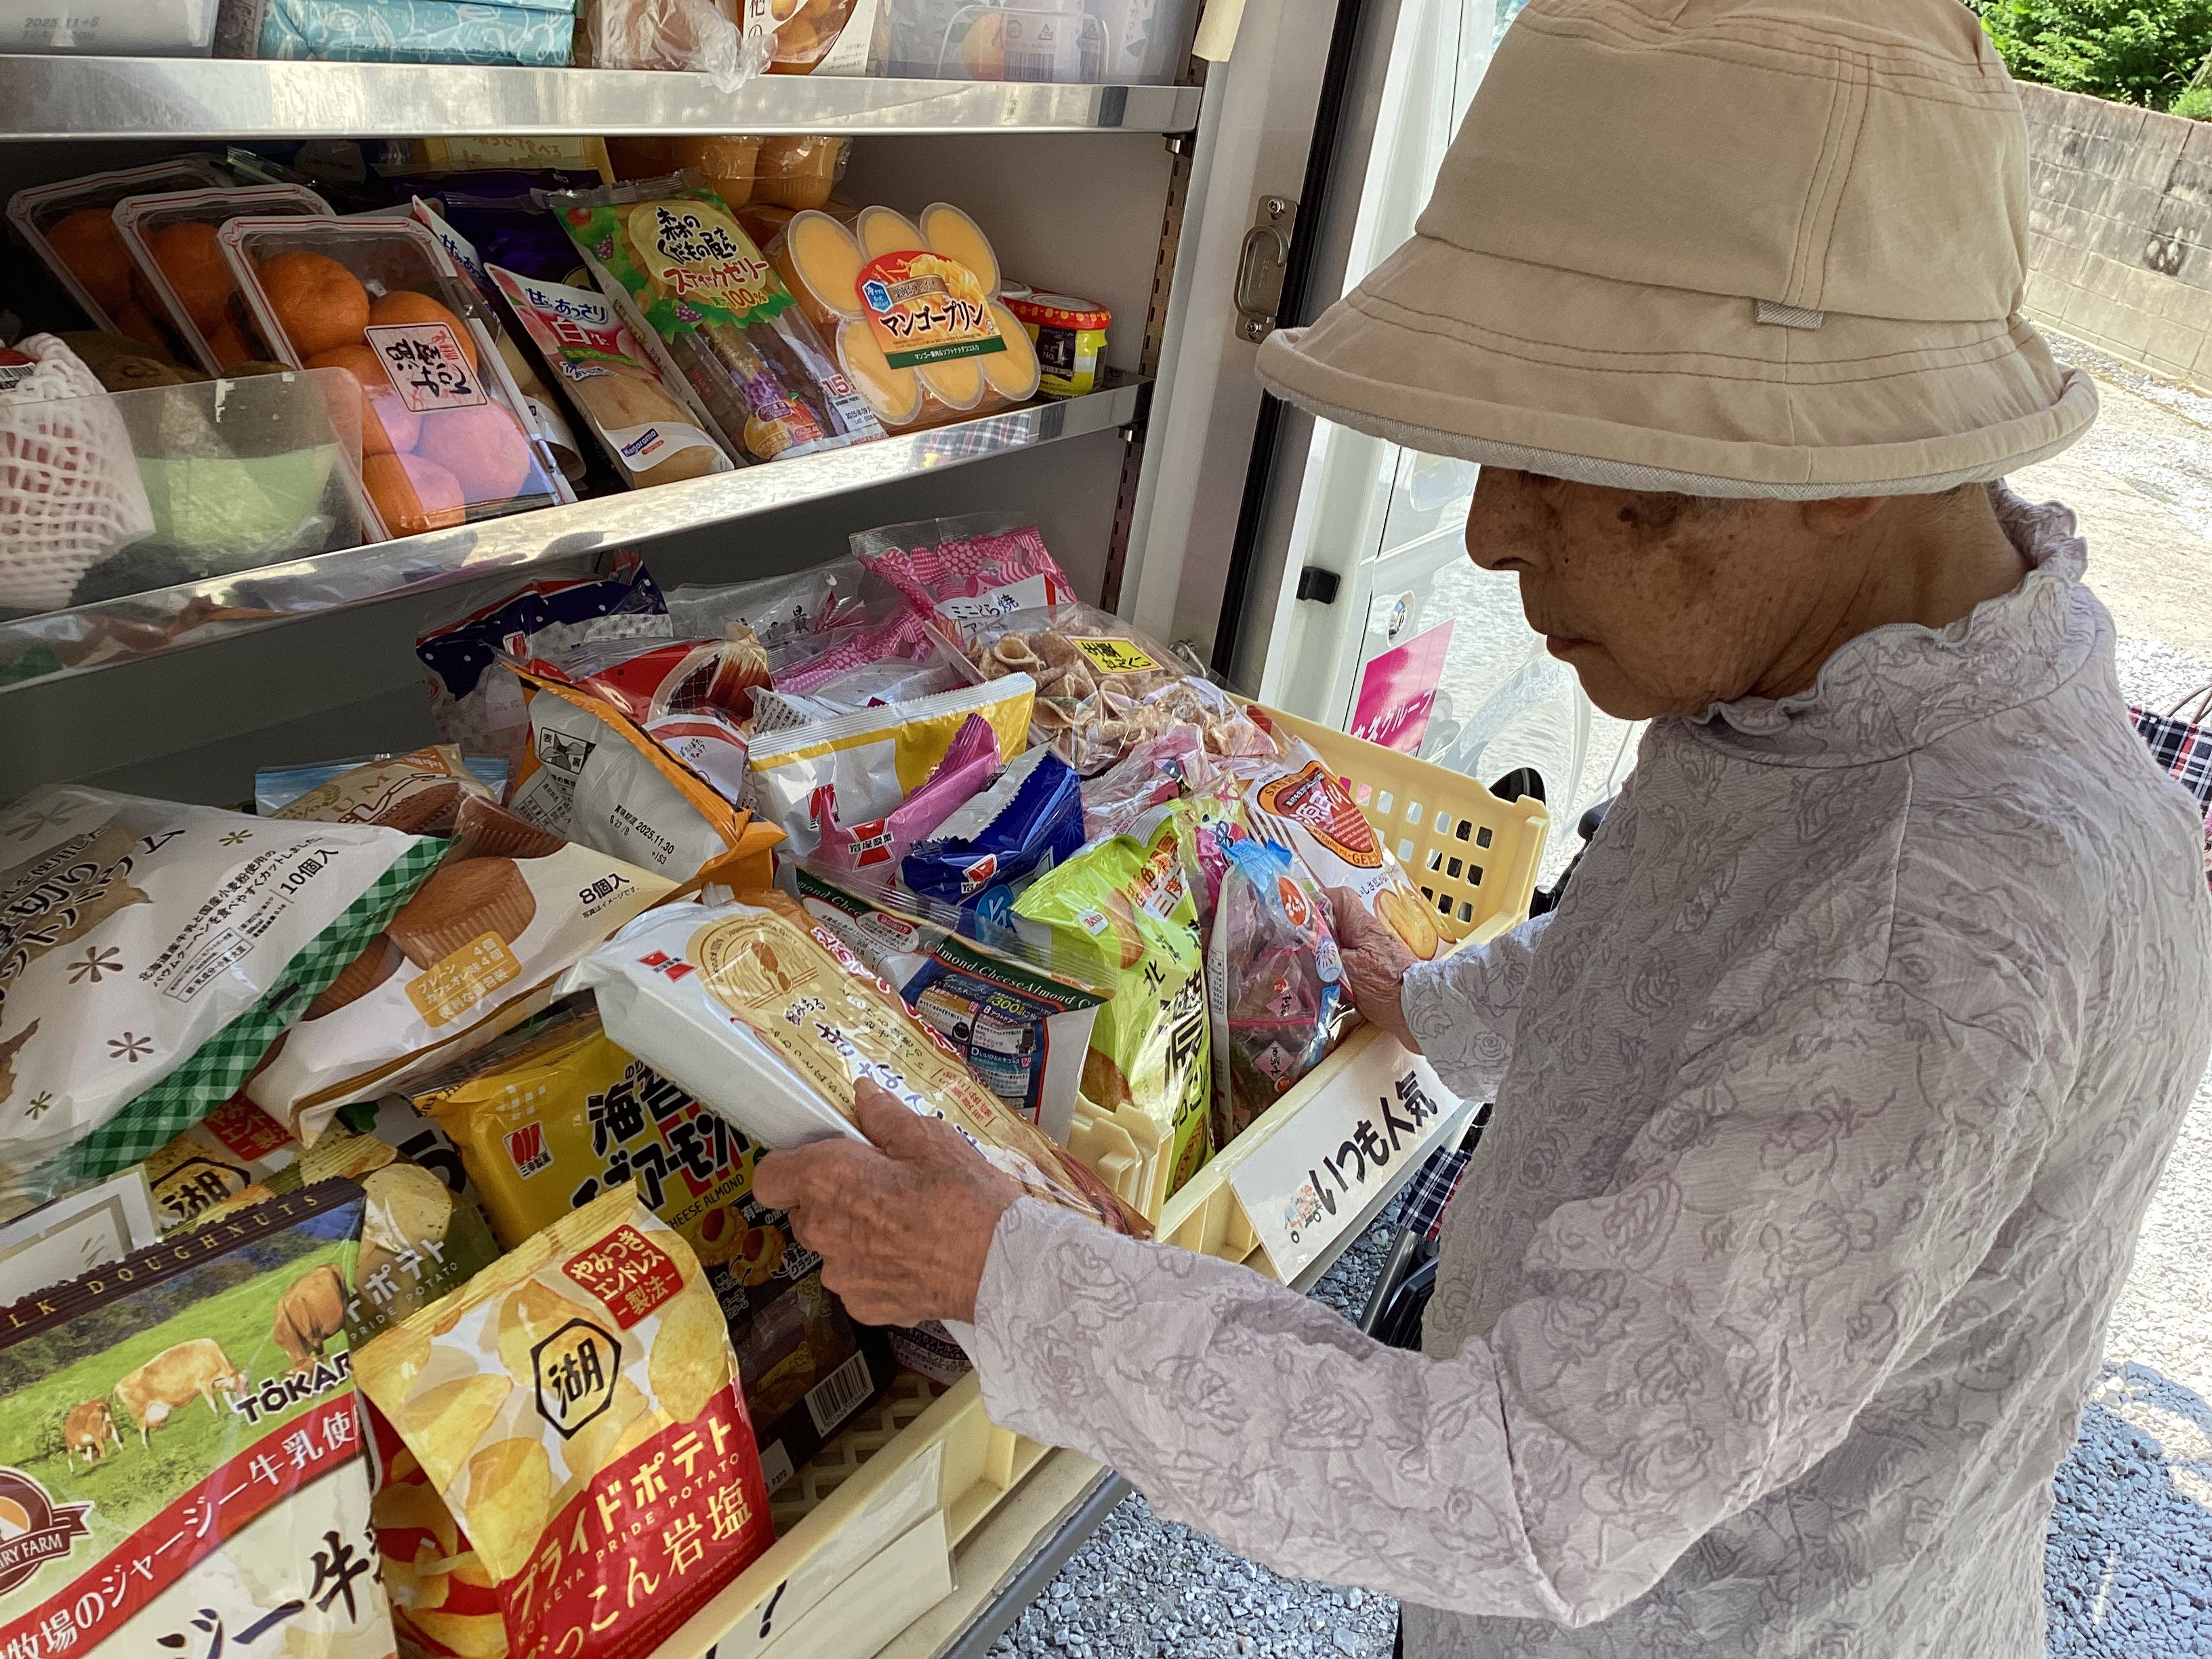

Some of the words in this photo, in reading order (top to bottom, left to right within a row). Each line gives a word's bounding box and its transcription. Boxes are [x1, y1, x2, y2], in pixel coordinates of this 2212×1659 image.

[657, 207, 701, 241] 森の
[657, 226, 737, 266] くだもの屋さん
[880, 300, 983, 337] マンゴープリン
[951, 593, 1019, 618] ミニどら焼
[636, 821, 676, 855] 2025.11.30
[281, 848, 340, 895] 10個入
[578, 872, 630, 905] 8個入
[1152, 865, 1184, 918] 三度
[581, 886, 640, 920] 写真はイメージです。
[1309, 1070, 1438, 1216] いつも人気
[703, 1174, 745, 1207] ALMOND
[90, 1194, 319, 1296] DOUGHNUTS
[569, 1229, 645, 1283] やみつき
[593, 1246, 668, 1302] エンドレス
[630, 1273, 671, 1315] 製法
[350, 1305, 396, 1343] PRIDE
[406, 1261, 457, 1303] POTATO
[546, 1338, 606, 1419] 湖
[510, 1416, 733, 1615] プライドポテト
[22, 1532, 63, 1558] FARM
[517, 1566, 587, 1647] KOIKEYA
[595, 1512, 658, 1562] PRIDE
[668, 1453, 741, 1509] POTATO
